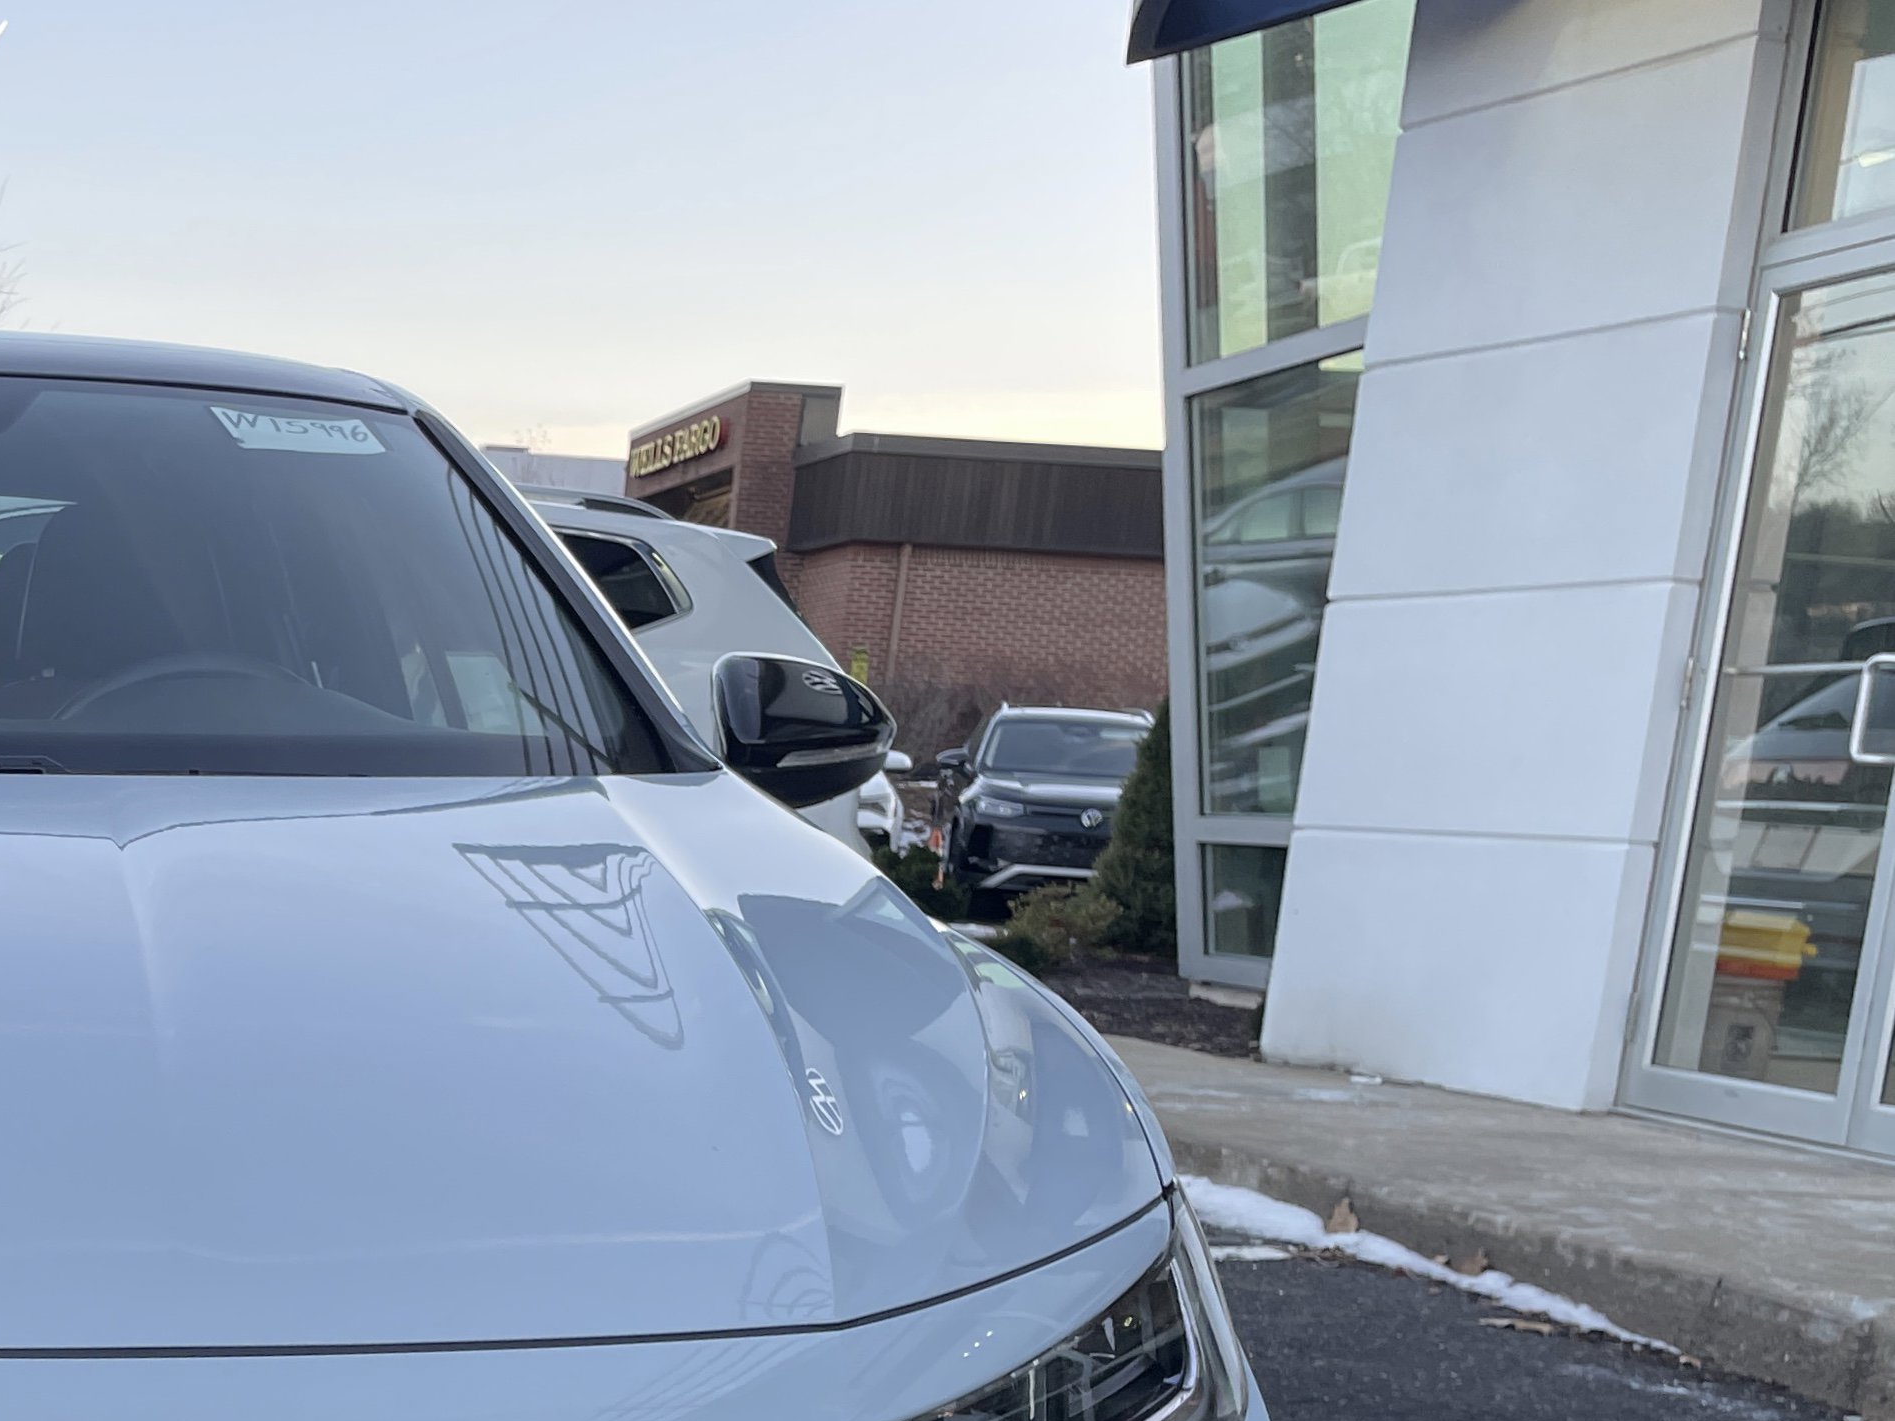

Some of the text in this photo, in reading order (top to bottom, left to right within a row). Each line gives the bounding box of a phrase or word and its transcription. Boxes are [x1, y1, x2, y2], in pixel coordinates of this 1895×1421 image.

[221, 410, 369, 443] W15996
[629, 415, 721, 478] WELLS FARGO
